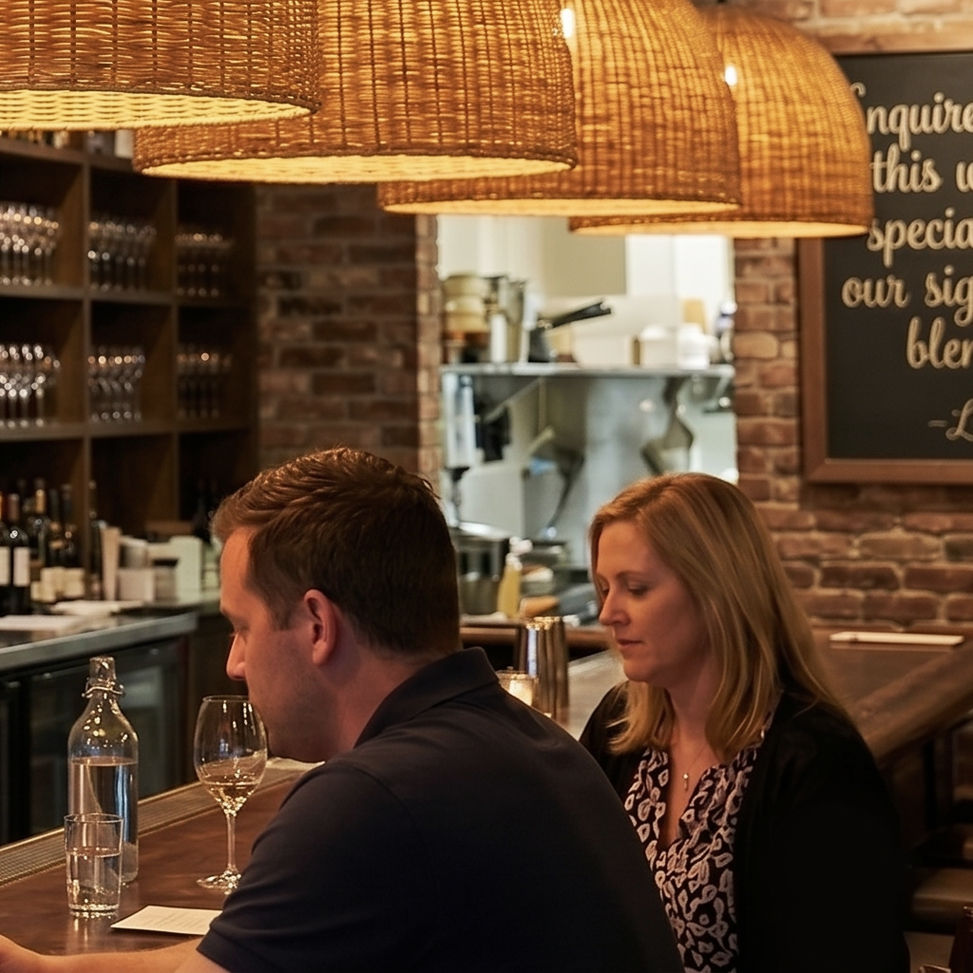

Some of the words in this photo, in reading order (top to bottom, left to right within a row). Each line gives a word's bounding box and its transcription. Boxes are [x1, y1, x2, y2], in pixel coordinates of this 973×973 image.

[850, 82, 973, 153] nquire
[869, 142, 944, 194] this
[842, 274, 912, 309] our
